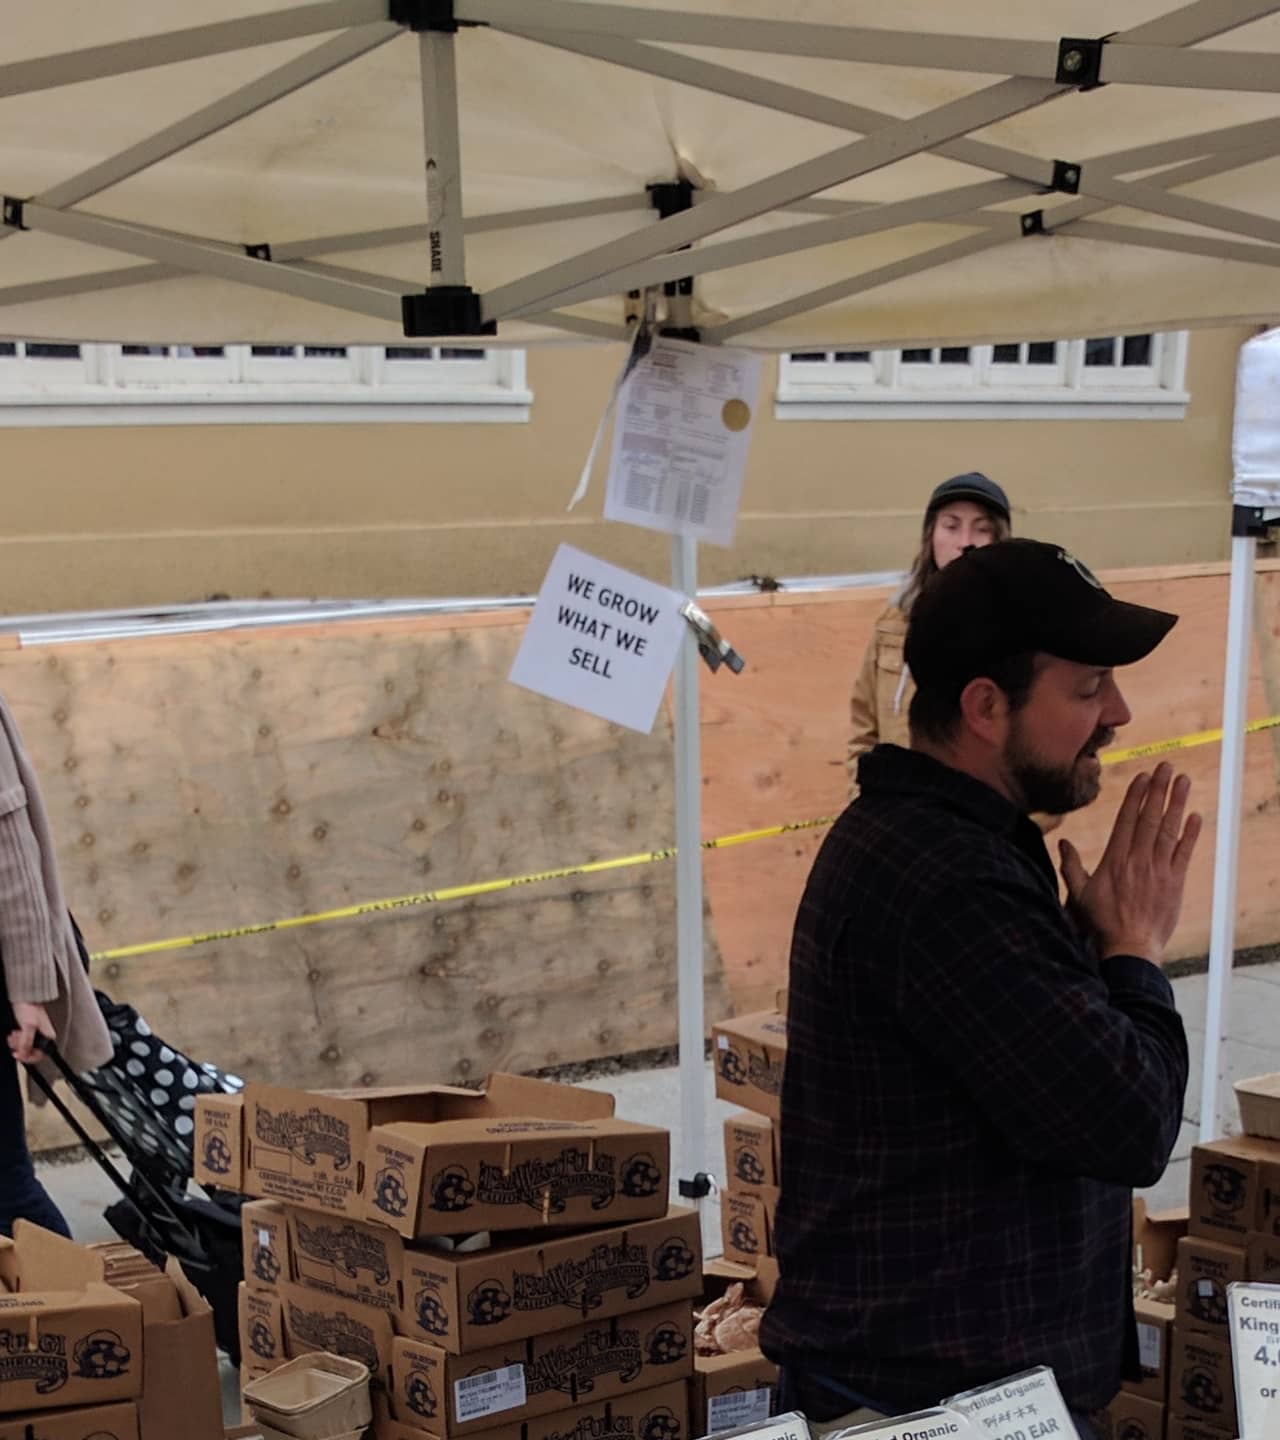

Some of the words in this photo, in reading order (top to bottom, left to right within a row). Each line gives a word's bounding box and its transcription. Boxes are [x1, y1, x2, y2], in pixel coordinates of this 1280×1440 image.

[568, 573, 595, 599] WE
[598, 587, 659, 625] GROW
[558, 605, 607, 641] WHAT
[615, 630, 648, 657] WE
[569, 647, 613, 679] SELL
[1240, 1317, 1279, 1335] King
[1003, 1378, 1046, 1399] Organic
[1260, 1386, 1277, 1399] or
[1028, 1417, 1060, 1439] EAR
